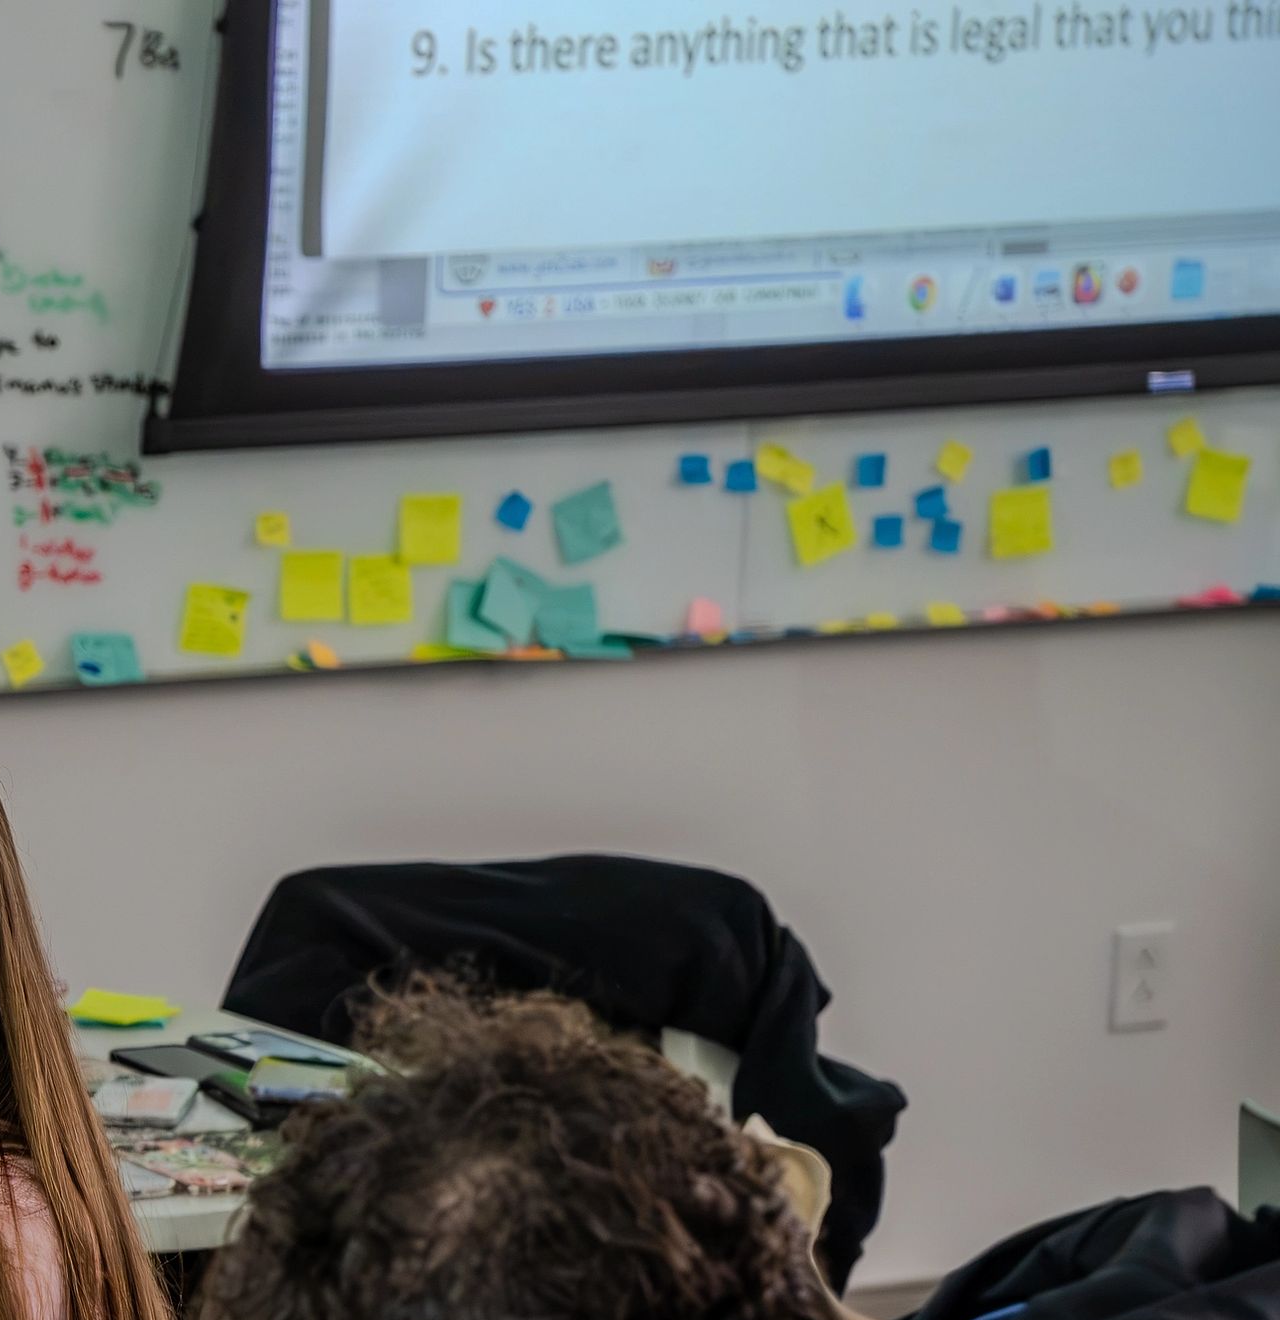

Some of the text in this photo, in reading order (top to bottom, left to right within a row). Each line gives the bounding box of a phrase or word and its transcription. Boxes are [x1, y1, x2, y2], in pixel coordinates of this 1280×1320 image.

[410, 28, 448, 78] 9.
[465, 27, 497, 74] Is
[508, 22, 619, 73] there
[628, 15, 808, 77] anything
[816, 10, 899, 59] that
[908, 8, 940, 57] is
[949, 2, 1043, 64] legal
[1052, 2, 1133, 50] that
[1142, 7, 1214, 57] you
